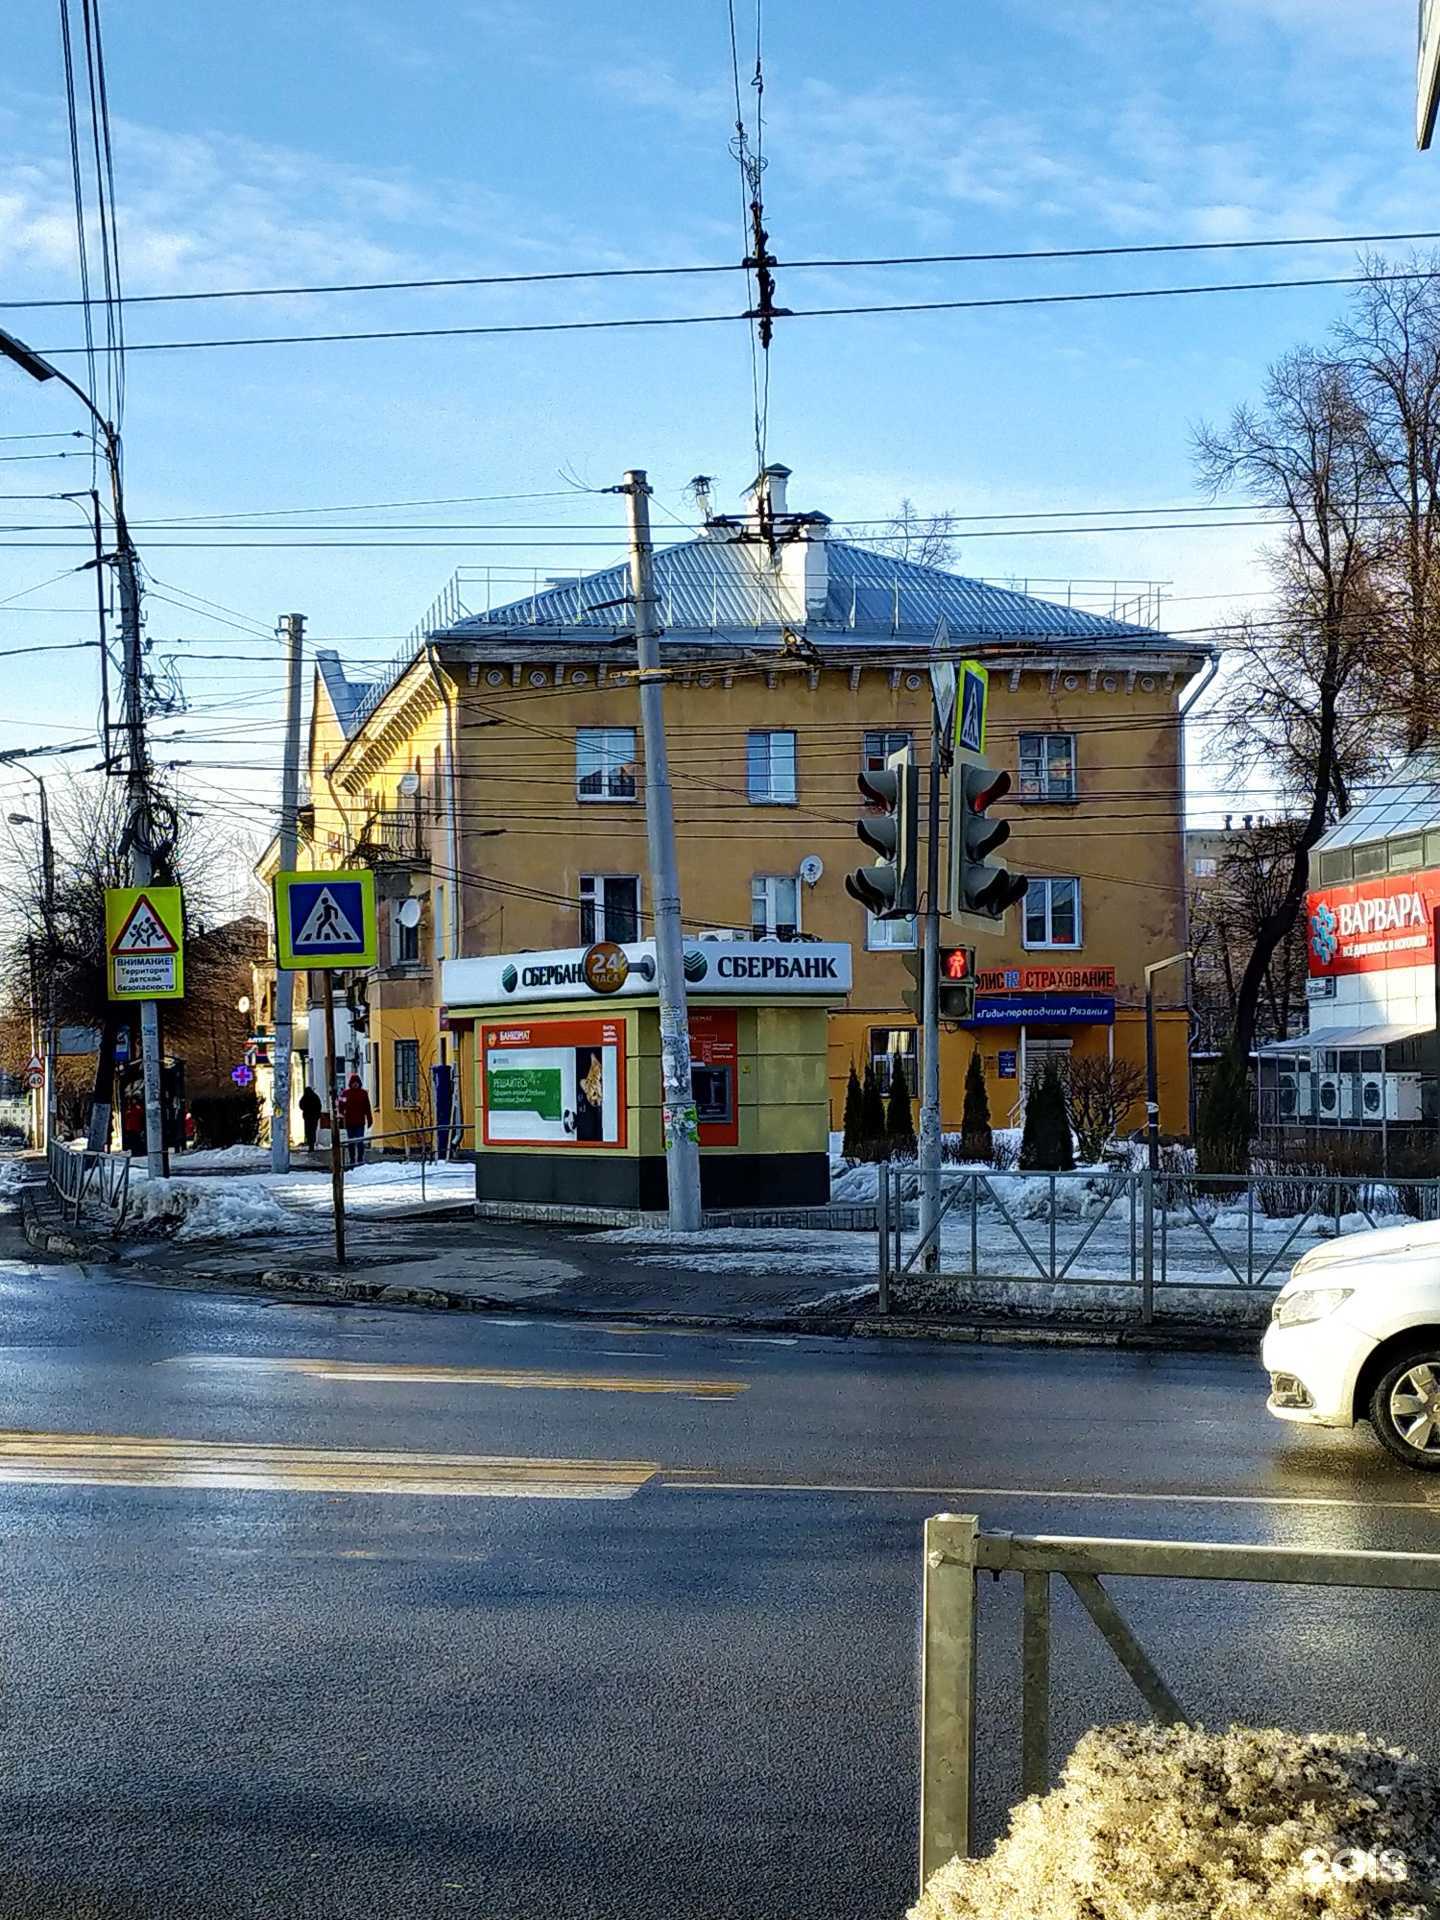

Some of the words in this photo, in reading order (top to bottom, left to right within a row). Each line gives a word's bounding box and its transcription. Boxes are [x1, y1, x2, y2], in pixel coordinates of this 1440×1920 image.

[1339, 892, 1425, 936] ВАРВАРА
[116, 957, 173, 966] ВНИМАНИЕ!
[121, 967, 170, 975] Территория
[592, 953, 619, 974] 24
[717, 956, 838, 978] СБЕРБАНК
[1026, 970, 1115, 988] СТРАХОВАНИЕ
